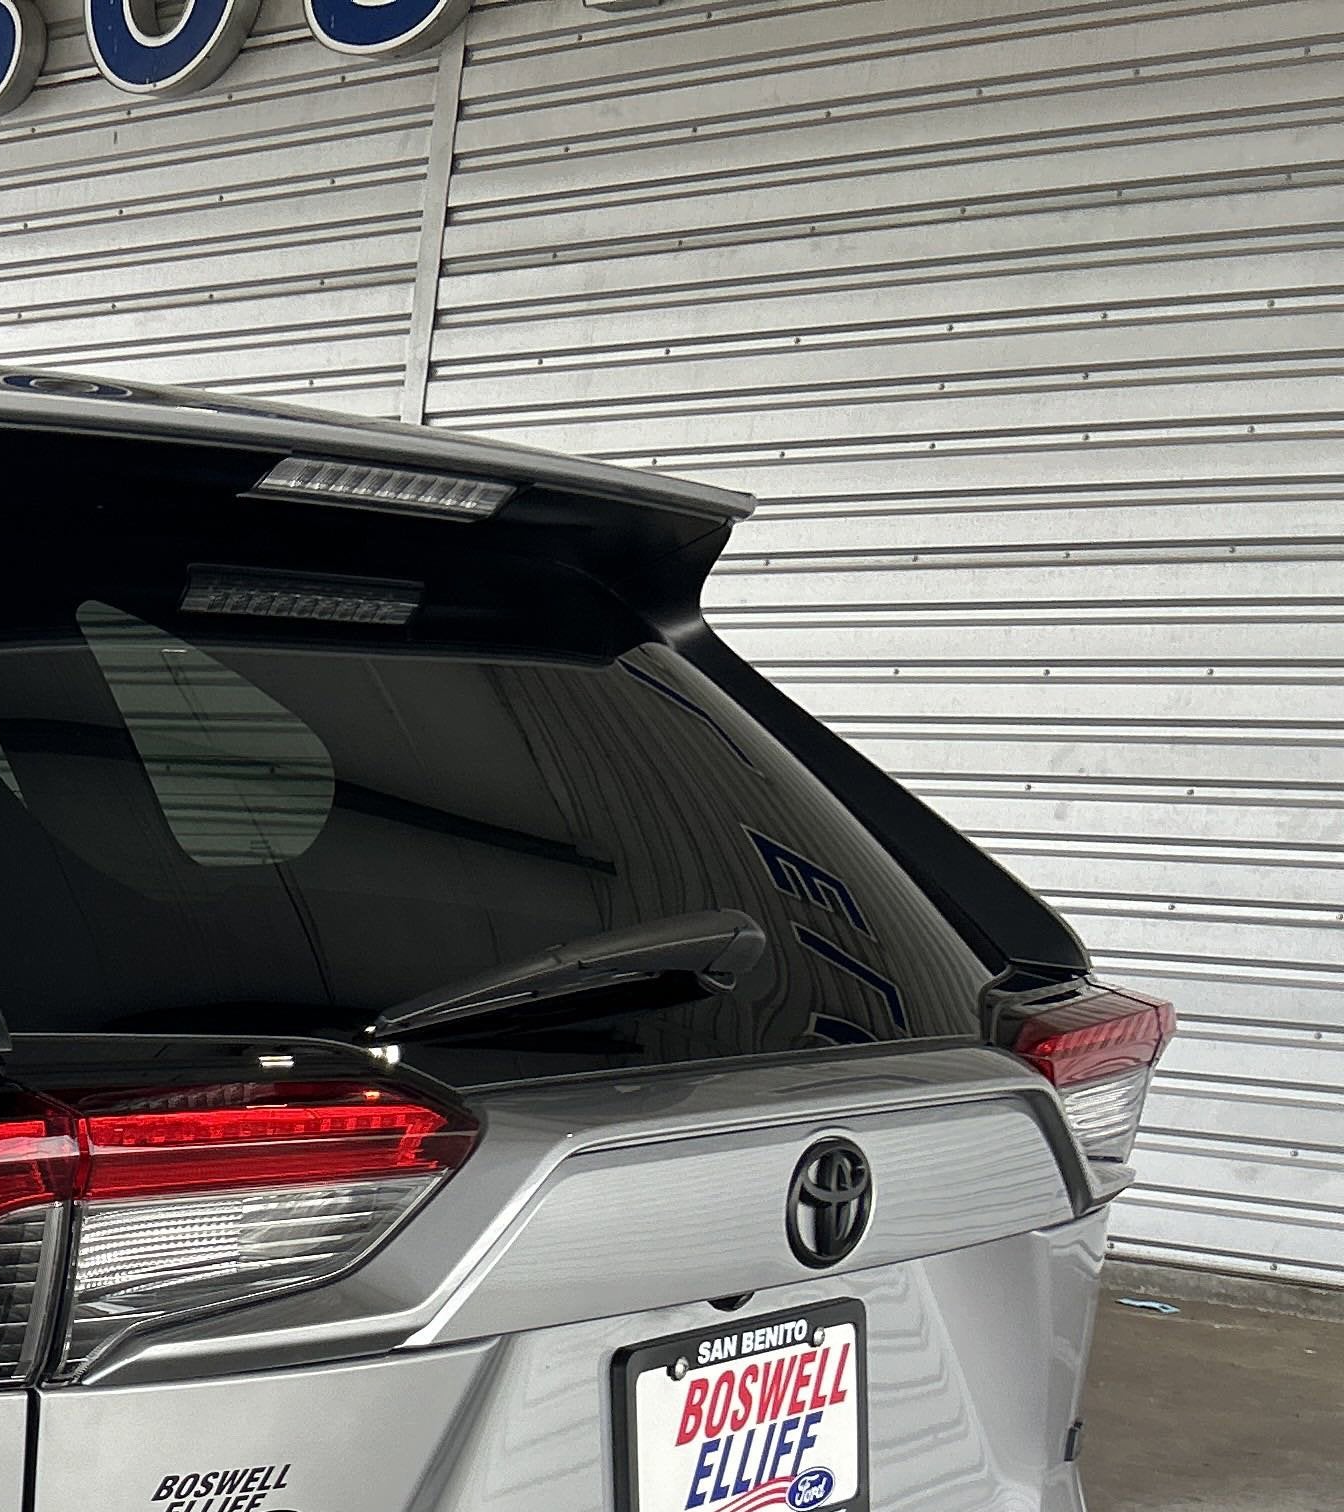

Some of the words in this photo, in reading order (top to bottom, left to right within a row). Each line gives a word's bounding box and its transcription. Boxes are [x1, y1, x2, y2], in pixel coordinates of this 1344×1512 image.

[697, 1335, 738, 1364] SAN
[741, 1318, 808, 1355] BENITO
[675, 1342, 850, 1447] BOSWELL
[151, 1464, 291, 1501] BOSWELL
[684, 1411, 824, 1511] ELLIFF
[795, 1472, 826, 1505] Ford
